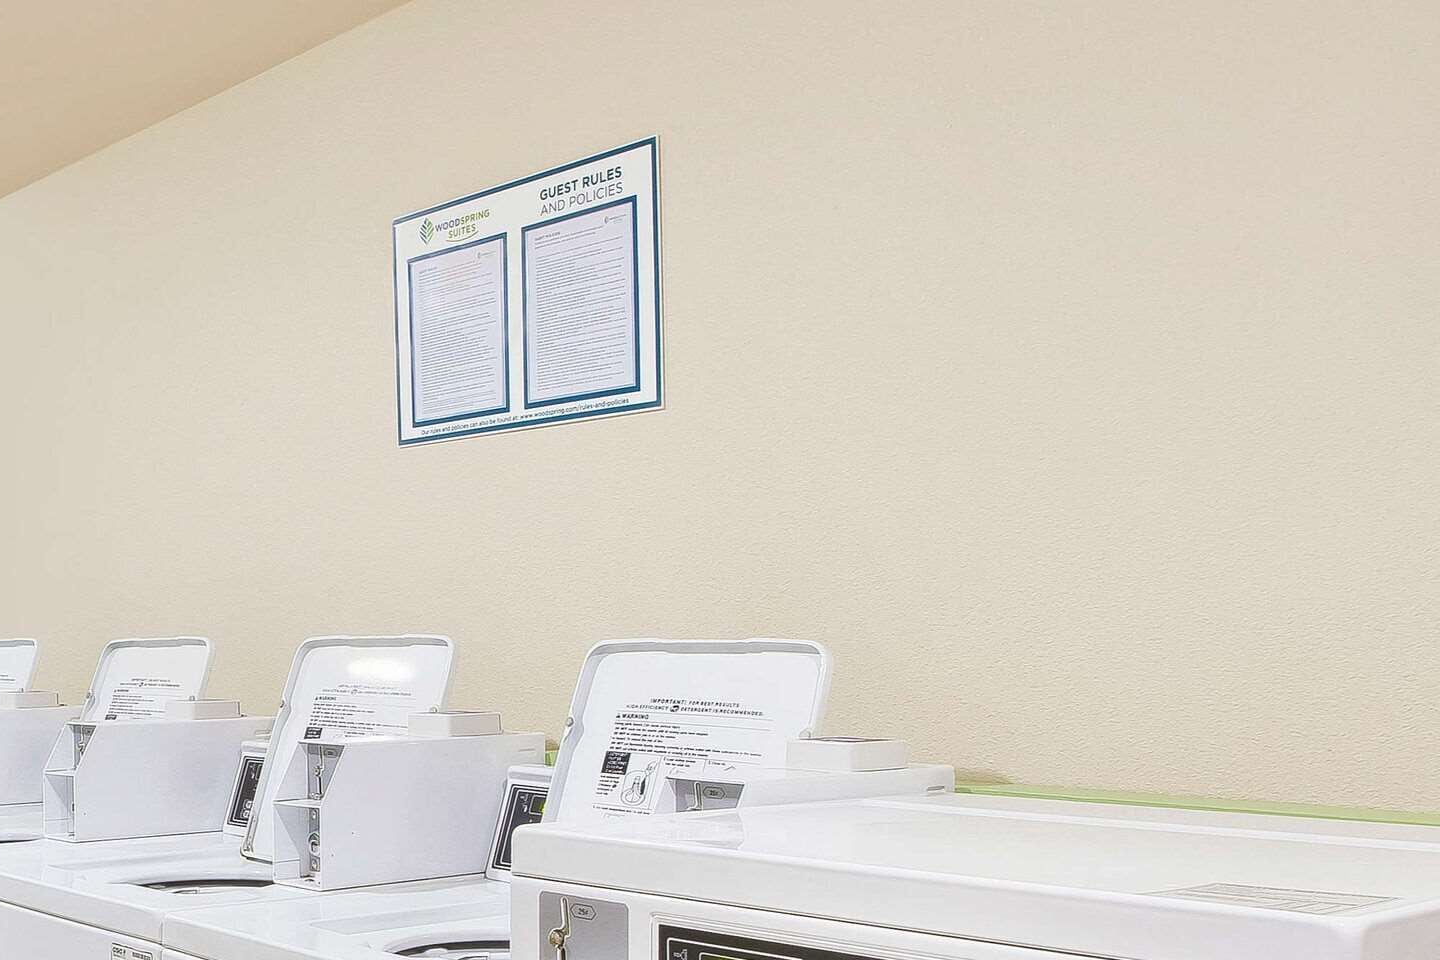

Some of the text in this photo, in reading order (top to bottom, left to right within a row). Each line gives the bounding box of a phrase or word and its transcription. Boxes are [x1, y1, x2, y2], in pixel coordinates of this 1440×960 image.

[539, 166, 622, 201] GUEST RULES
[540, 182, 624, 216] AND POLICIES
[435, 209, 490, 233] WOODSPRING
[448, 224, 476, 239] SUITES
[451, 423, 469, 431] policies
